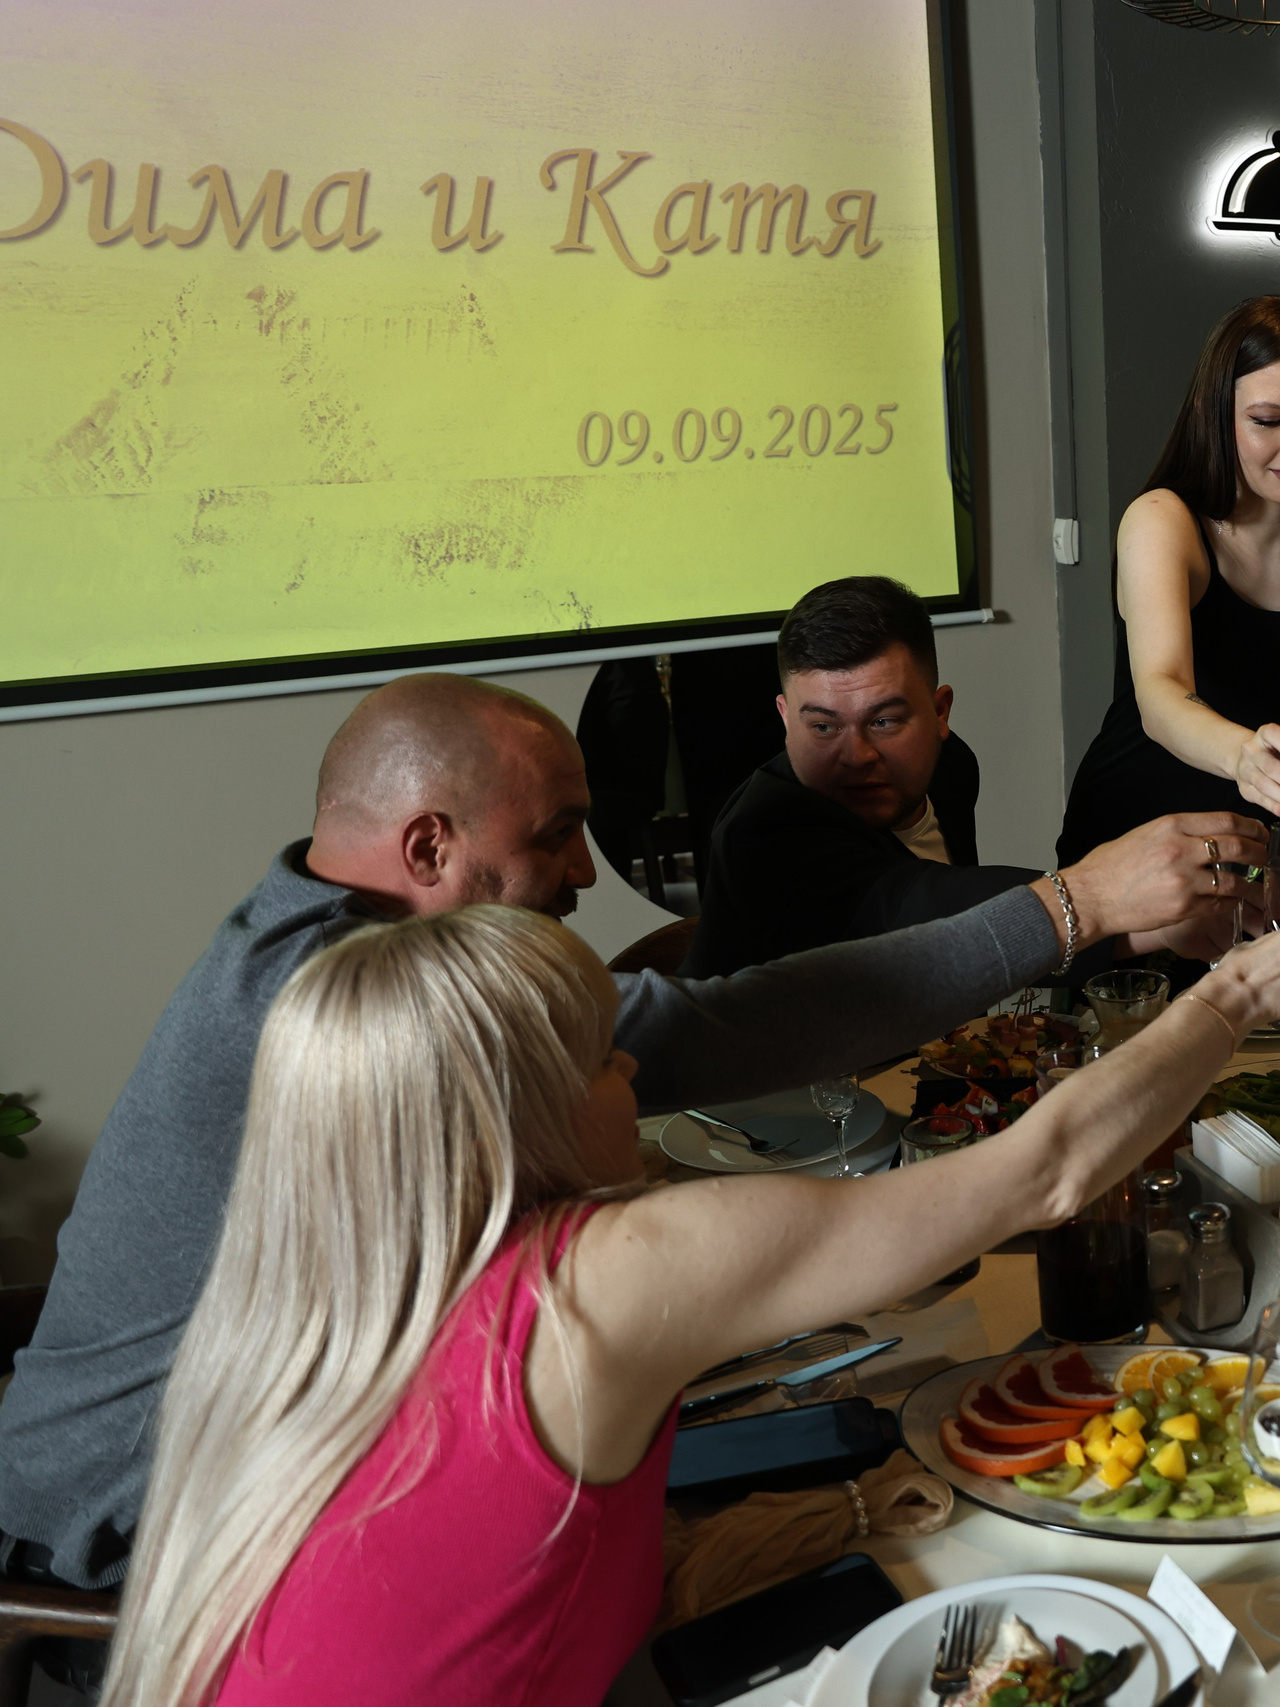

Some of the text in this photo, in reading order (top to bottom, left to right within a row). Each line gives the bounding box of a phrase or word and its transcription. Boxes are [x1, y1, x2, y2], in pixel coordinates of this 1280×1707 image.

[420, 172, 502, 252] и
[539, 147, 881, 277] Катя
[576, 402, 898, 467] 09.09.2025
